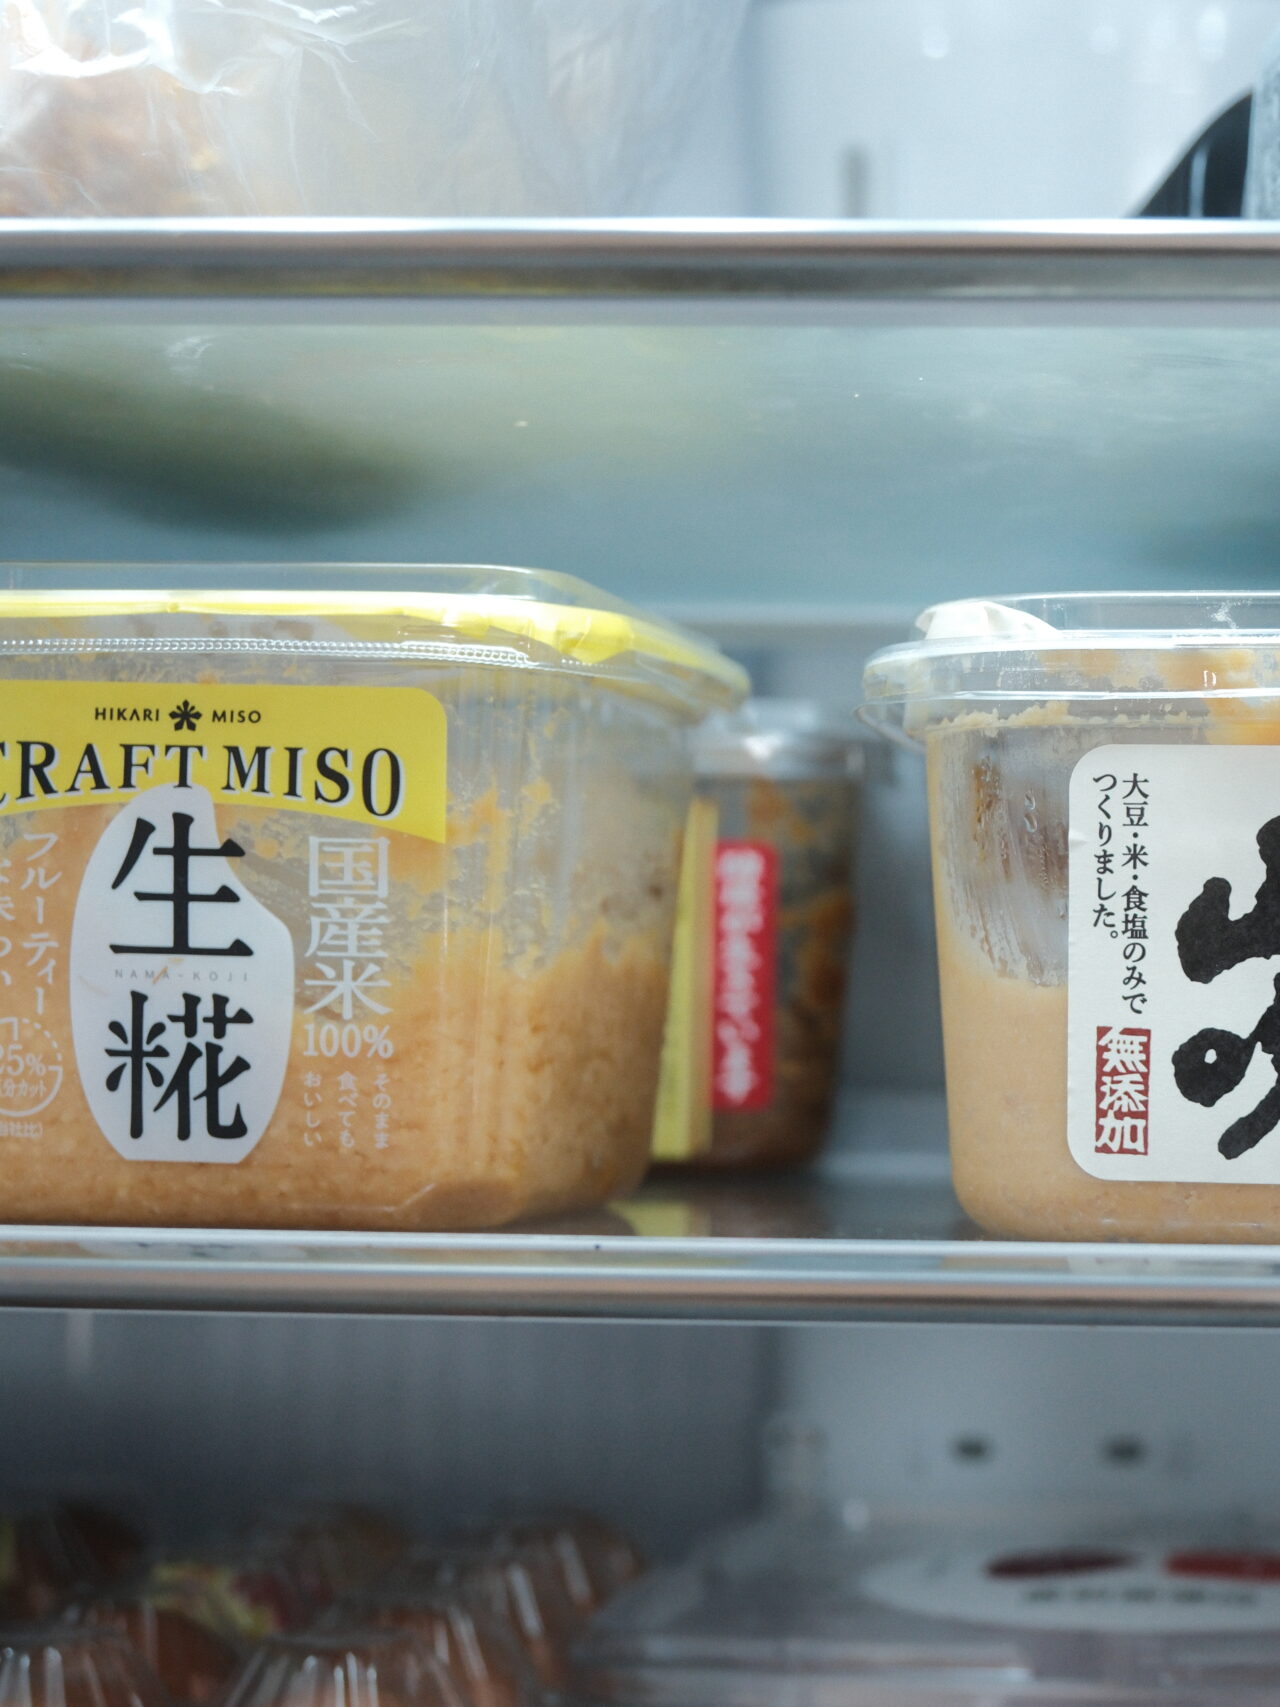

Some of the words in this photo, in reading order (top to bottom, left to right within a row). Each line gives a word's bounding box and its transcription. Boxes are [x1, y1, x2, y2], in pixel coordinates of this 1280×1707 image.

[94, 707, 160, 722] HIKARI
[211, 710, 262, 724] MISO
[0, 740, 205, 804] RAFT
[222, 745, 401, 817] MISO
[1092, 772, 1119, 940] つくりました。
[1121, 772, 1150, 1014] 大豆・米・食塩のみで
[20, 831, 63, 1015] フルーティー
[303, 836, 394, 1020] 国産米
[303, 1023, 394, 1059] 100%
[303, 1070, 322, 1148] おいしい
[337, 1070, 359, 1149] 食べても
[372, 1065, 392, 1150] そのまま
[1095, 1029, 1150, 1155] 無添加
